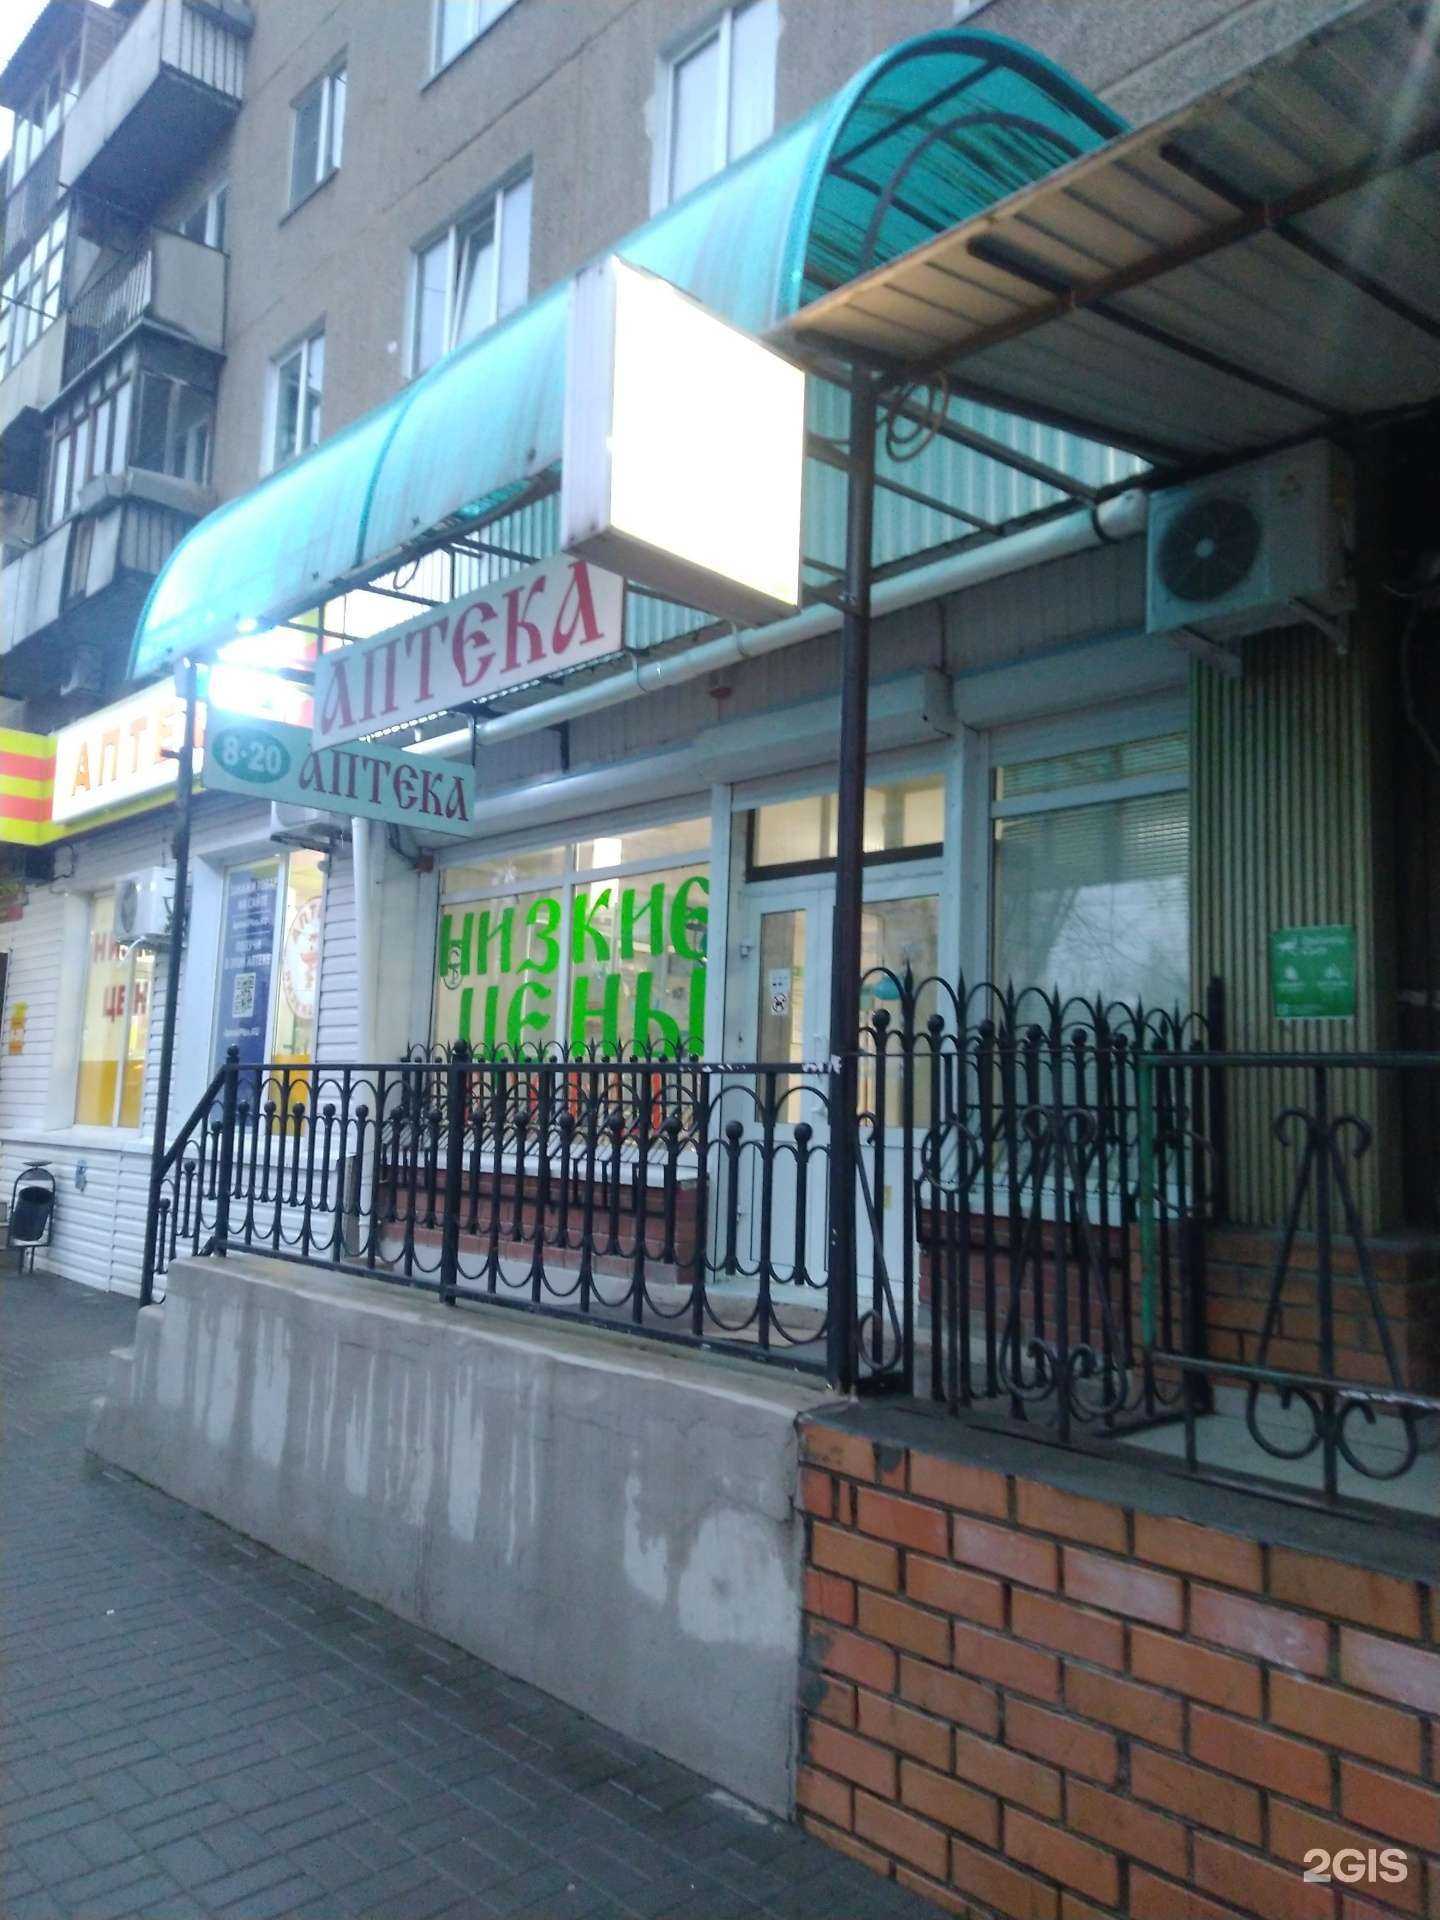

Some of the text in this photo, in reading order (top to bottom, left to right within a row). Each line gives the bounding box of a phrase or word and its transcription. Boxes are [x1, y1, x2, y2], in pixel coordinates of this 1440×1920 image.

[320, 559, 605, 736] АПТЕКА
[299, 751, 470, 822] АПТЕКА
[439, 876, 710, 976] НИЗКИЕ
[458, 966, 707, 1066] ЦЕНЫ
